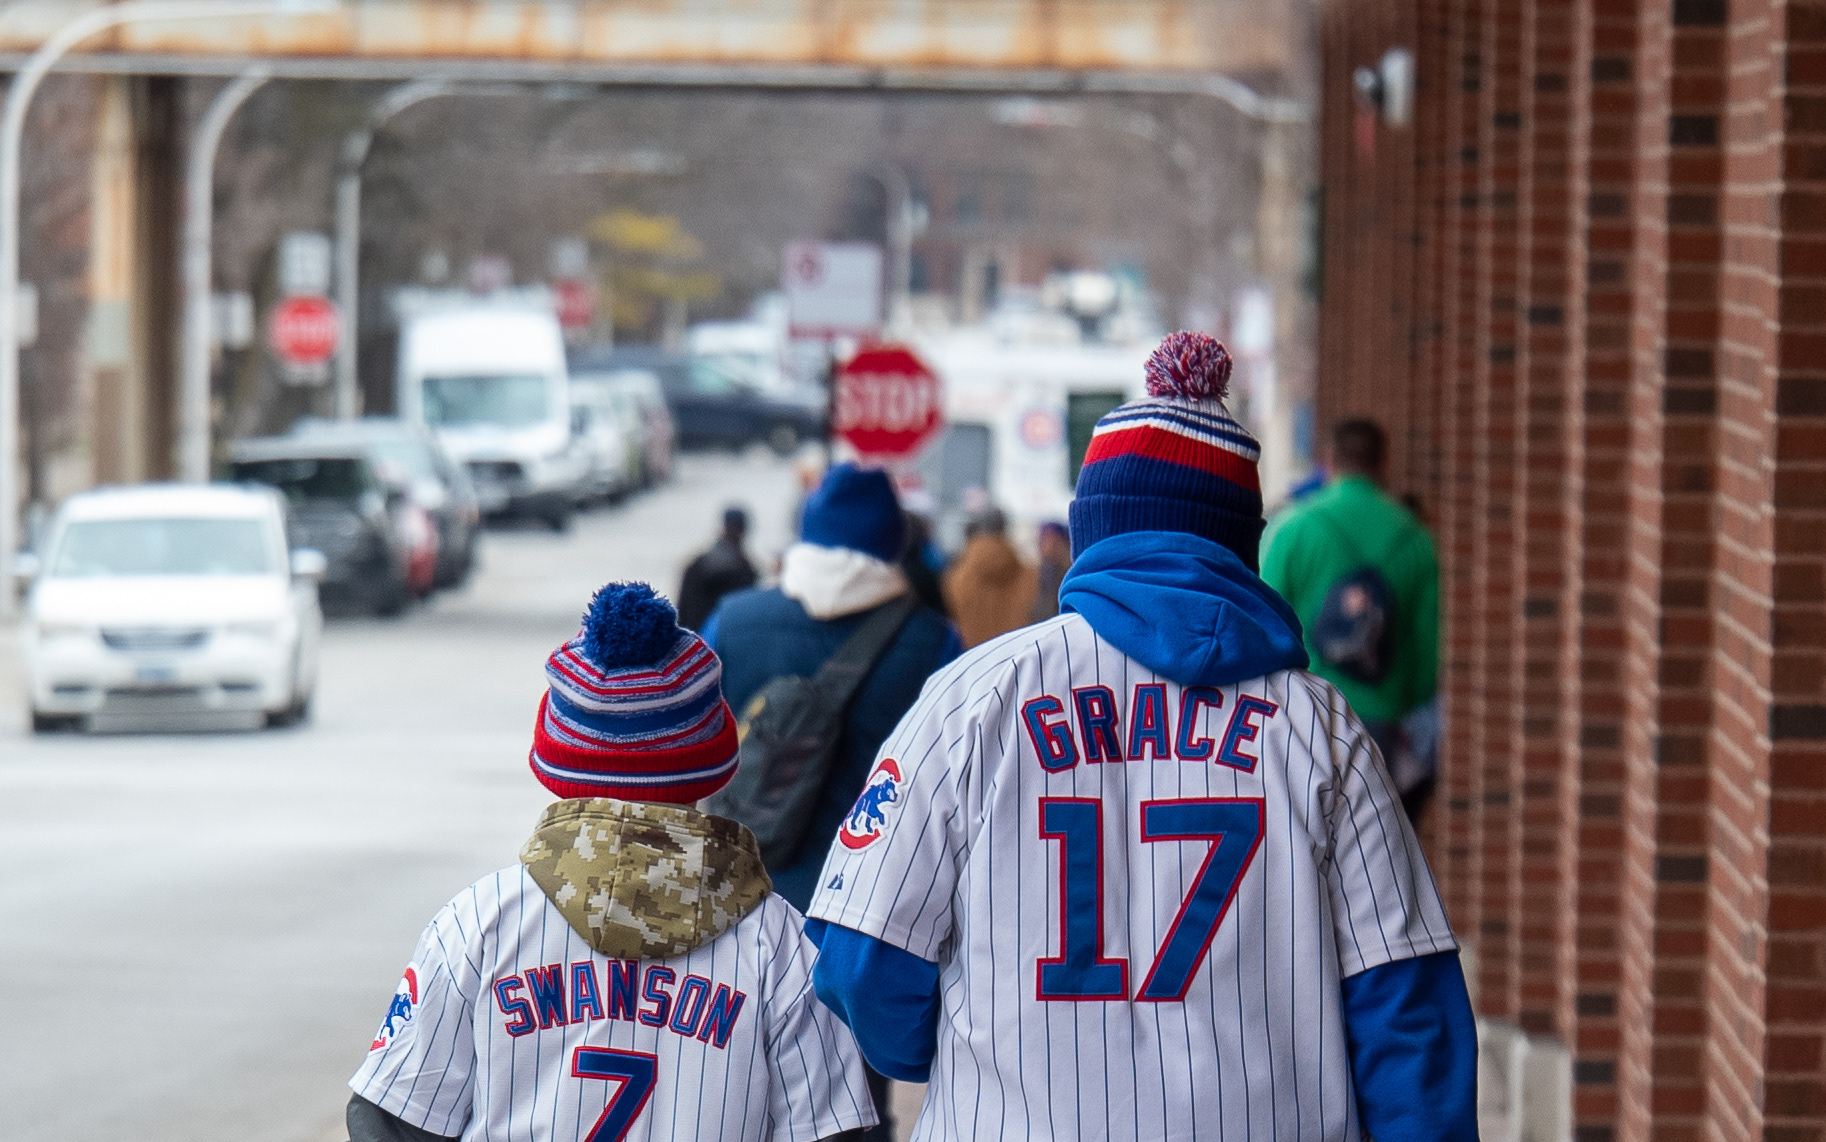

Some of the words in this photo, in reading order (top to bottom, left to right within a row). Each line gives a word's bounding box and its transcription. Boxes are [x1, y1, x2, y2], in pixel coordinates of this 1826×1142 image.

[837, 371, 935, 431] STOP
[1021, 683, 1279, 774] GRACE
[1036, 797, 1266, 1002] 17
[493, 959, 747, 1049] SWANSON
